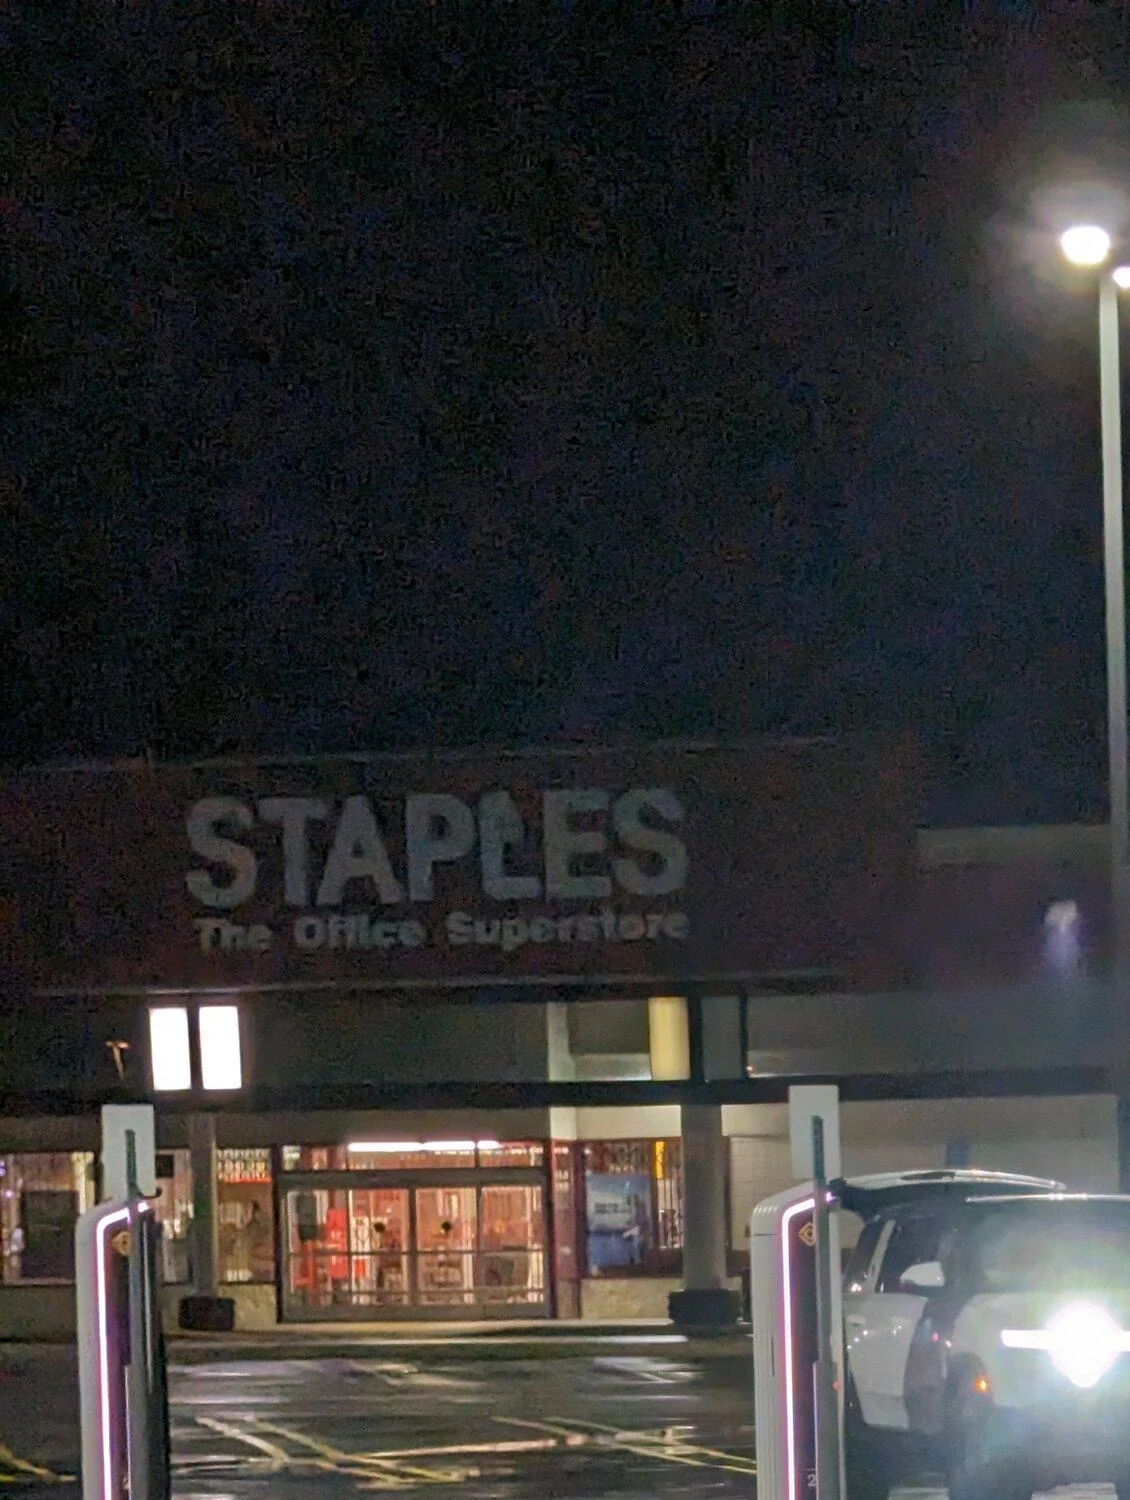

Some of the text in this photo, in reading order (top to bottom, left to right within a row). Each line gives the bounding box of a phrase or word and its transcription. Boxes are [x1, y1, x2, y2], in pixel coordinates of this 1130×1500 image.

[186, 789, 688, 907] STAPLES
[197, 911, 690, 951] The Office Superstore
